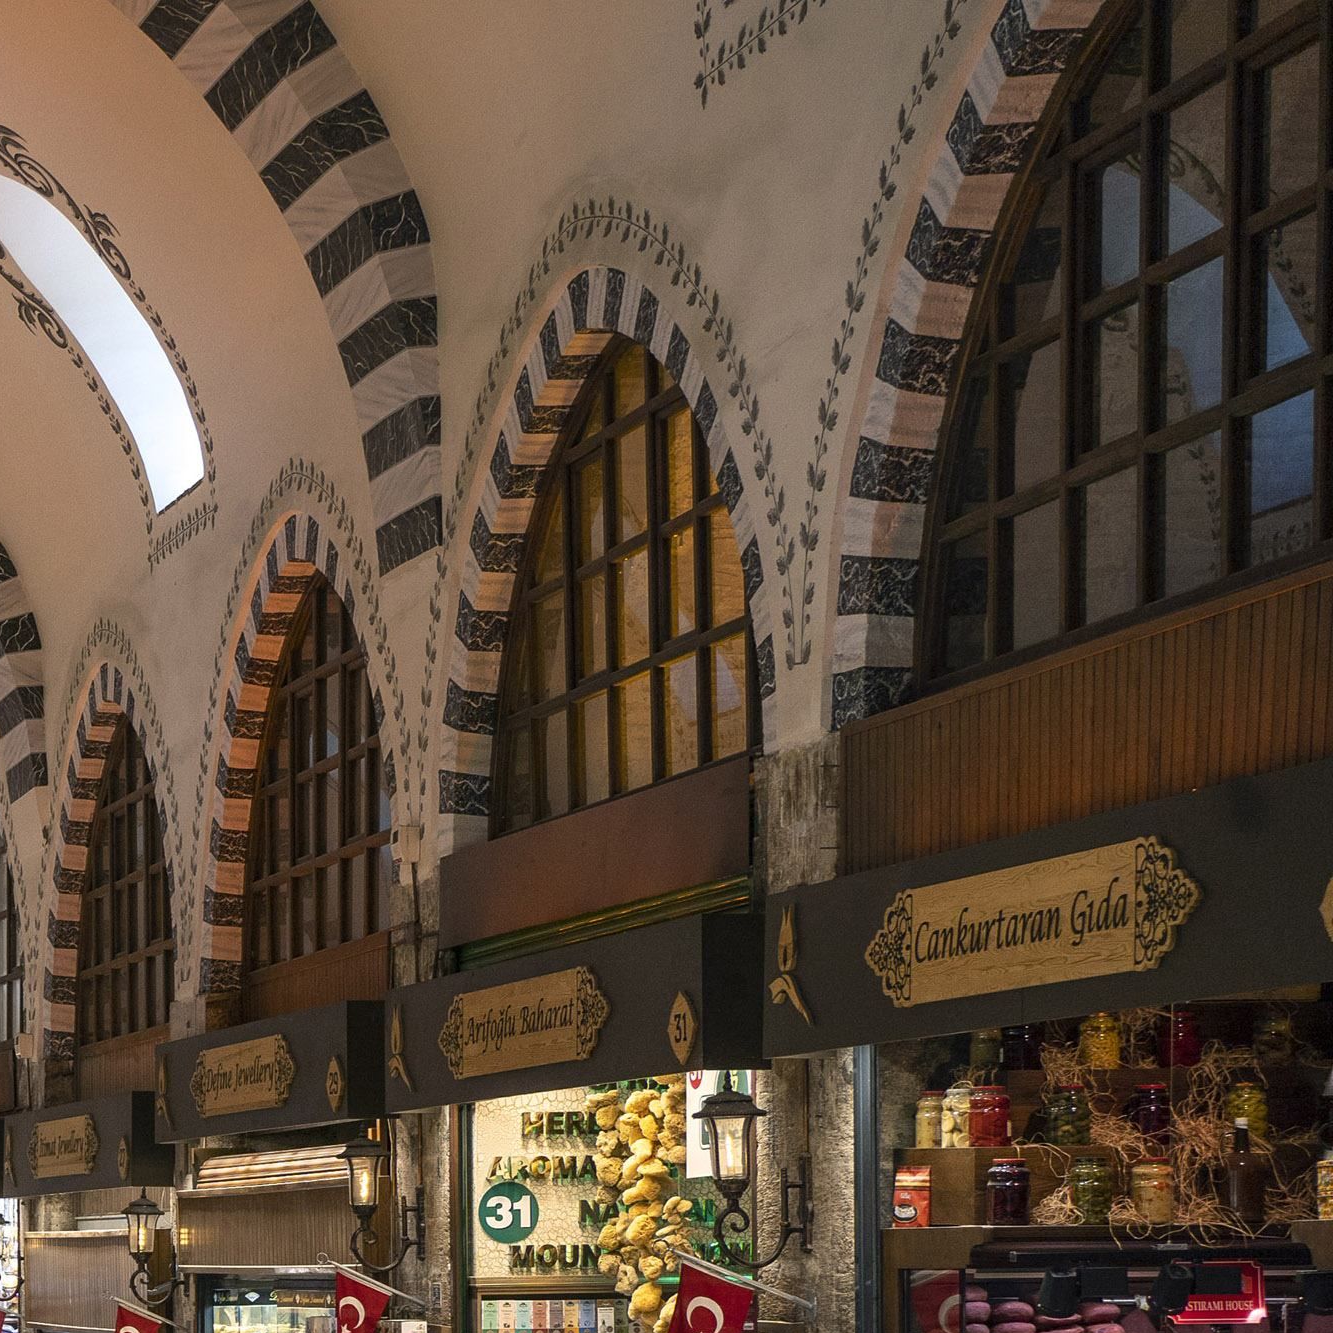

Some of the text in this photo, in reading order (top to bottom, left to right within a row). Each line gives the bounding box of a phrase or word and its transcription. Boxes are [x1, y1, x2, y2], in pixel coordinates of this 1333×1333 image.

[915, 877, 1129, 963] Cankurtaran Gıda
[465, 998, 575, 1053] Arifoğlu Baharat
[674, 1013, 688, 1044] 31
[206, 1055, 275, 1100] Define Jewellery
[485, 1194, 532, 1229] 31
[1185, 1300, 1254, 1311] STIRAMI HOUSE
